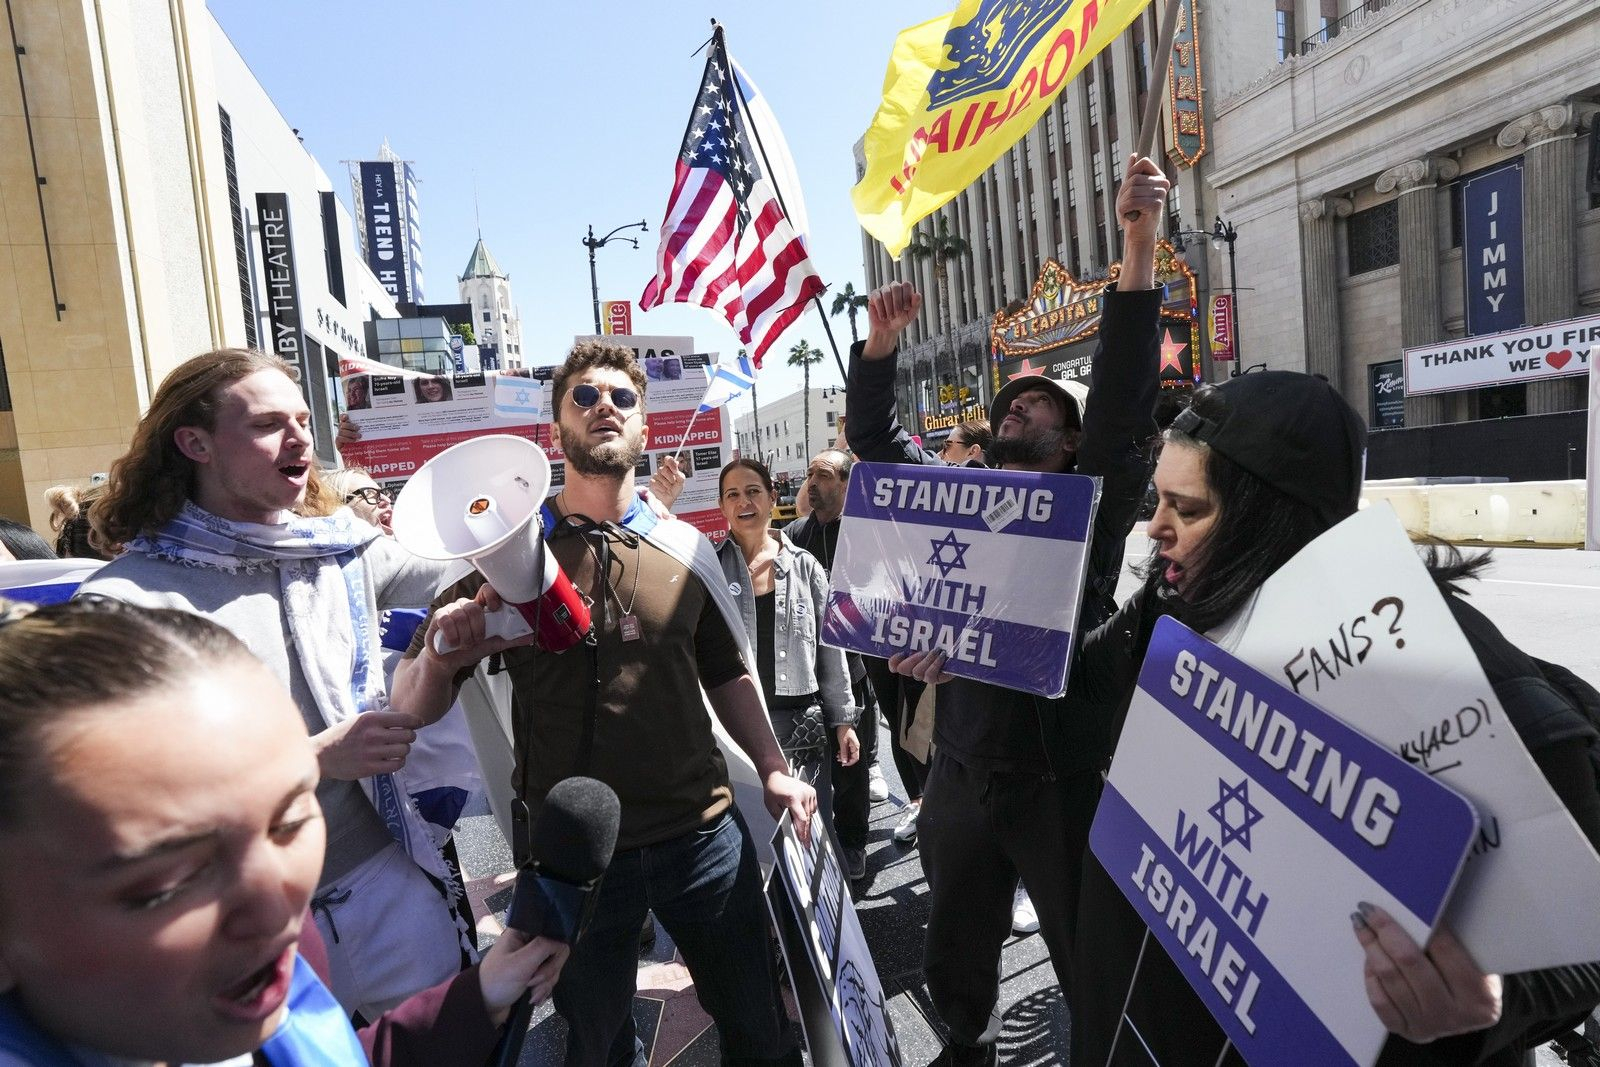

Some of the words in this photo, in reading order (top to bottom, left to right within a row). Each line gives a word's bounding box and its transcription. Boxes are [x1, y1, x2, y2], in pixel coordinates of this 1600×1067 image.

[373, 202, 394, 261] TREND
[1483, 191, 1507, 313] JIMMY
[263, 208, 294, 316] THEATRE
[1013, 324, 1028, 339] EL
[1031, 298, 1099, 331] CAPITAN
[1213, 297, 1230, 348] Annie
[1061, 368, 1078, 380] GAL
[1421, 344, 1495, 368] THANK
[1502, 334, 1553, 355] YOU
[1508, 357, 1541, 373] WE
[654, 430, 719, 445] KIDNAPPED
[872, 477, 1054, 523] STANDING
[900, 574, 987, 615] WITH
[870, 612, 998, 668] ISRAEL
[1283, 596, 1405, 692] FANS?
[1168, 648, 1402, 850] STANDING
[1173, 808, 1270, 937] WITH
[1130, 843, 1263, 1036] ISRAEL
